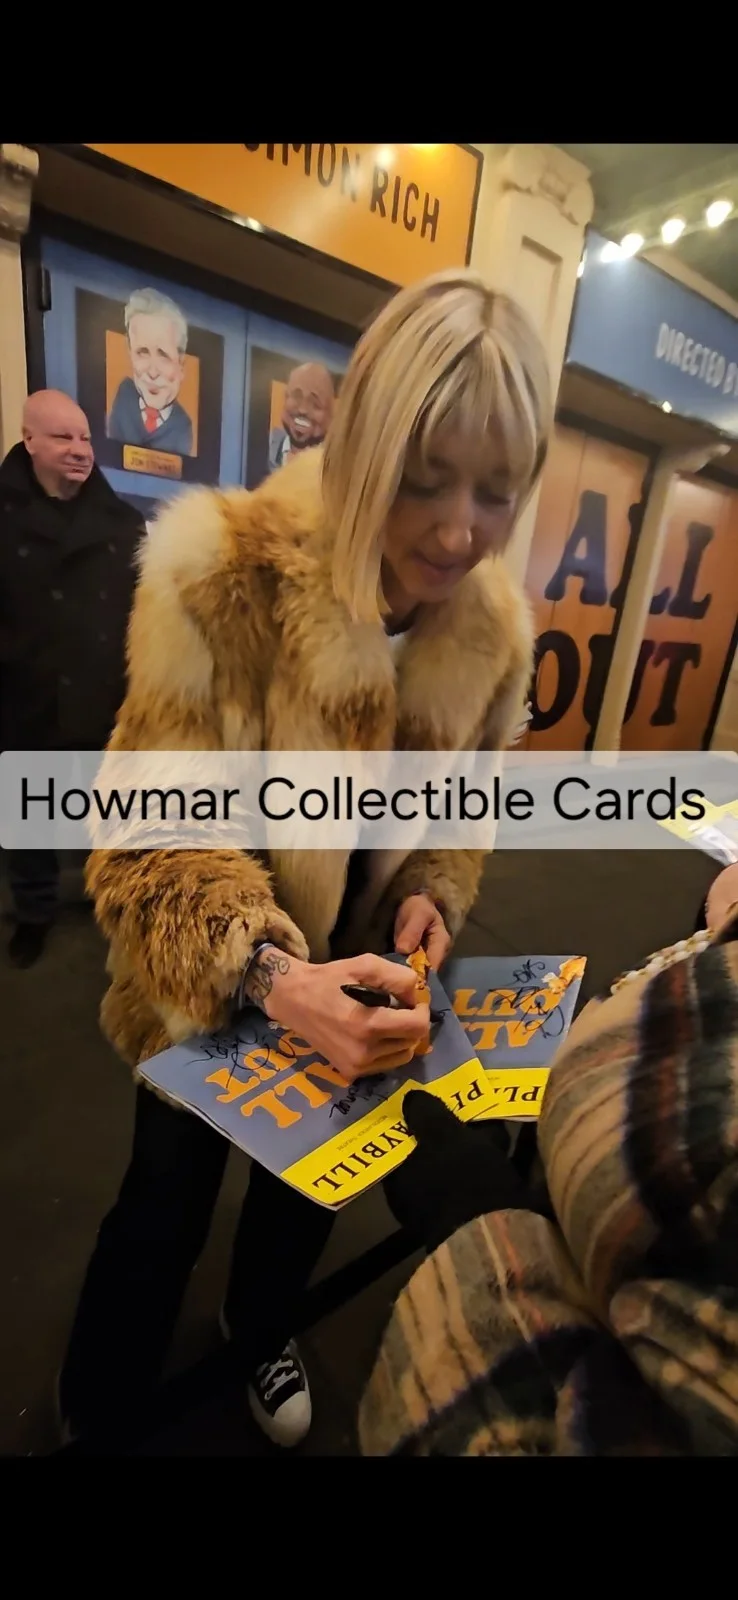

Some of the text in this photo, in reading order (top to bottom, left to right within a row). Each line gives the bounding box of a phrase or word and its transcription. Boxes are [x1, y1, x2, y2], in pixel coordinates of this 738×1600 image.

[370, 163, 440, 243] RICH
[655, 322, 726, 388] DIRECTED
[530, 630, 702, 732] OUT
